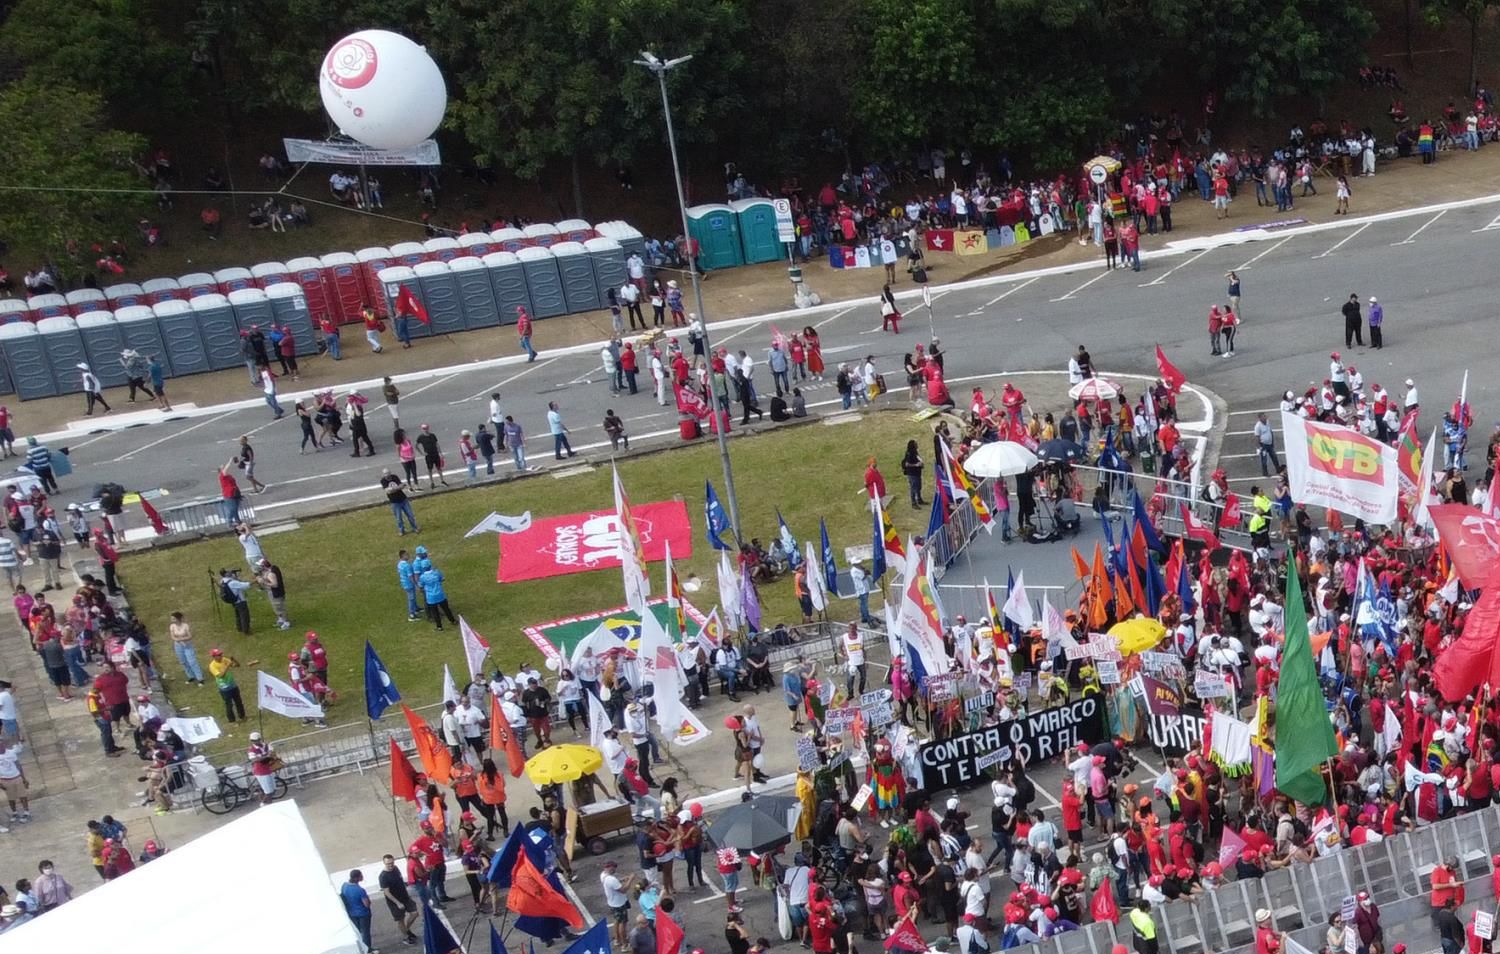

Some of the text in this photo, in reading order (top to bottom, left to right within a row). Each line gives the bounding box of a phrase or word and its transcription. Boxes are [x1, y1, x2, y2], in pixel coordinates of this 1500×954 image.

[1311, 432, 1379, 476] CTB
[922, 698, 1097, 767] CONTRA O MARCO
